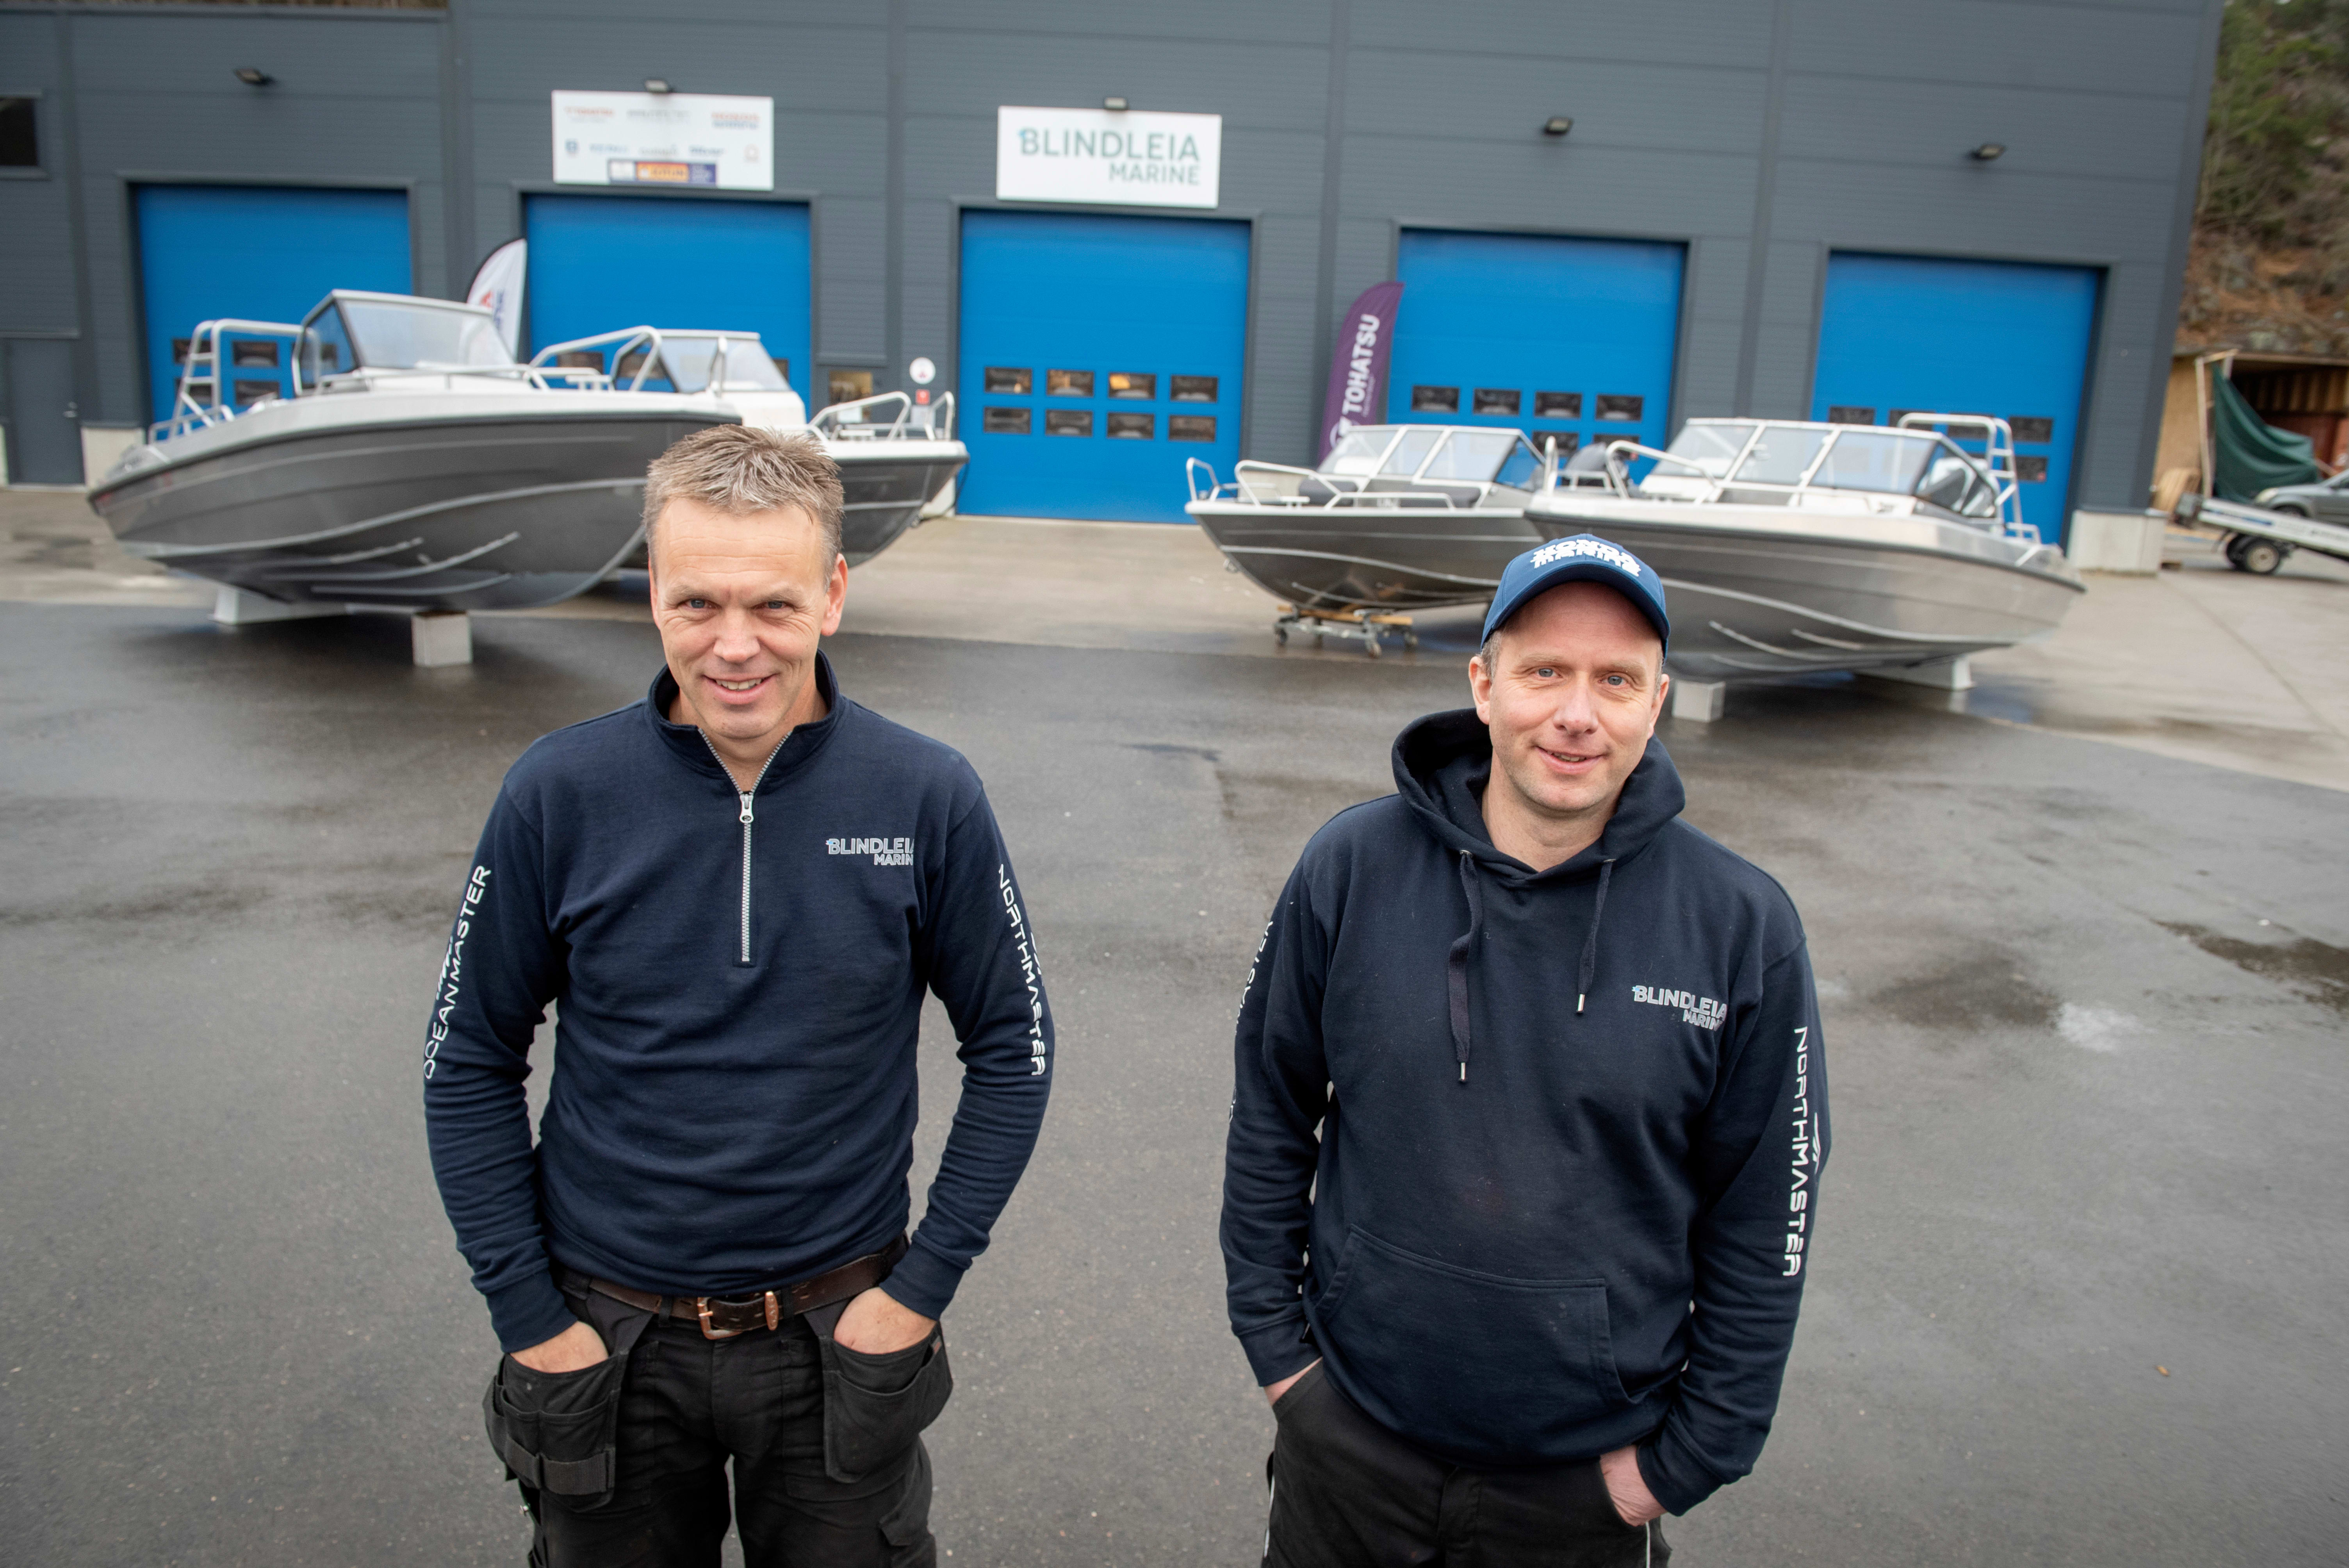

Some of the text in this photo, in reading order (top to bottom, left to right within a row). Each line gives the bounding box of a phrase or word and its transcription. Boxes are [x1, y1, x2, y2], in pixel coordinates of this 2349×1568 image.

[1020, 127, 1200, 162] BLINDLEIA
[1109, 161, 1201, 185] MARINE
[1342, 314, 1380, 415] TOHATSU
[1530, 539, 1641, 571] HONDA
[874, 853, 913, 866] MARIN
[423, 866, 492, 1079] OCEANMASTER
[998, 864, 1046, 1076] NORTHMASTER
[1634, 985, 1728, 1022] BLINDLEIA
[1782, 1026, 1809, 1276] NORTHMASTER
